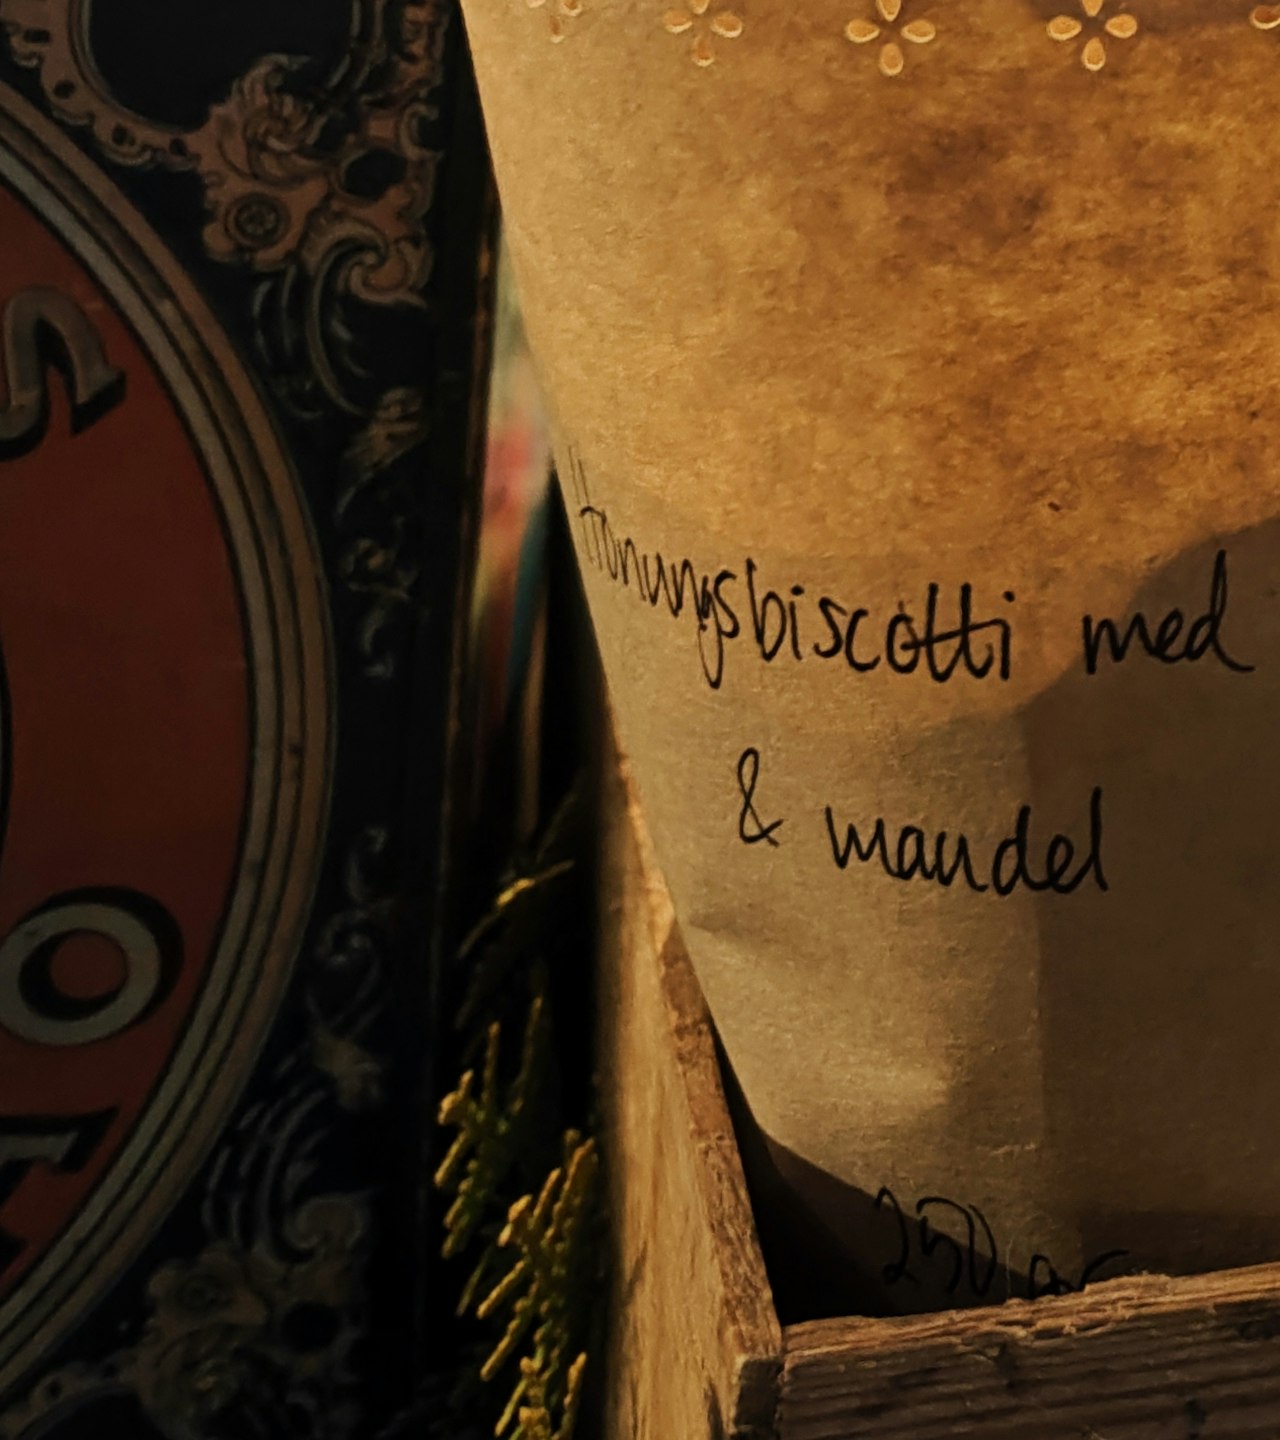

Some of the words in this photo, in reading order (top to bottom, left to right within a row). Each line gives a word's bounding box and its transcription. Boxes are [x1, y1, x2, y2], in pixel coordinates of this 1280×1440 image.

[1081, 549, 1255, 675] med
[736, 746, 784, 848] &
[824, 785, 1110, 897] mandel
[875, 1185, 998, 1298] 250
